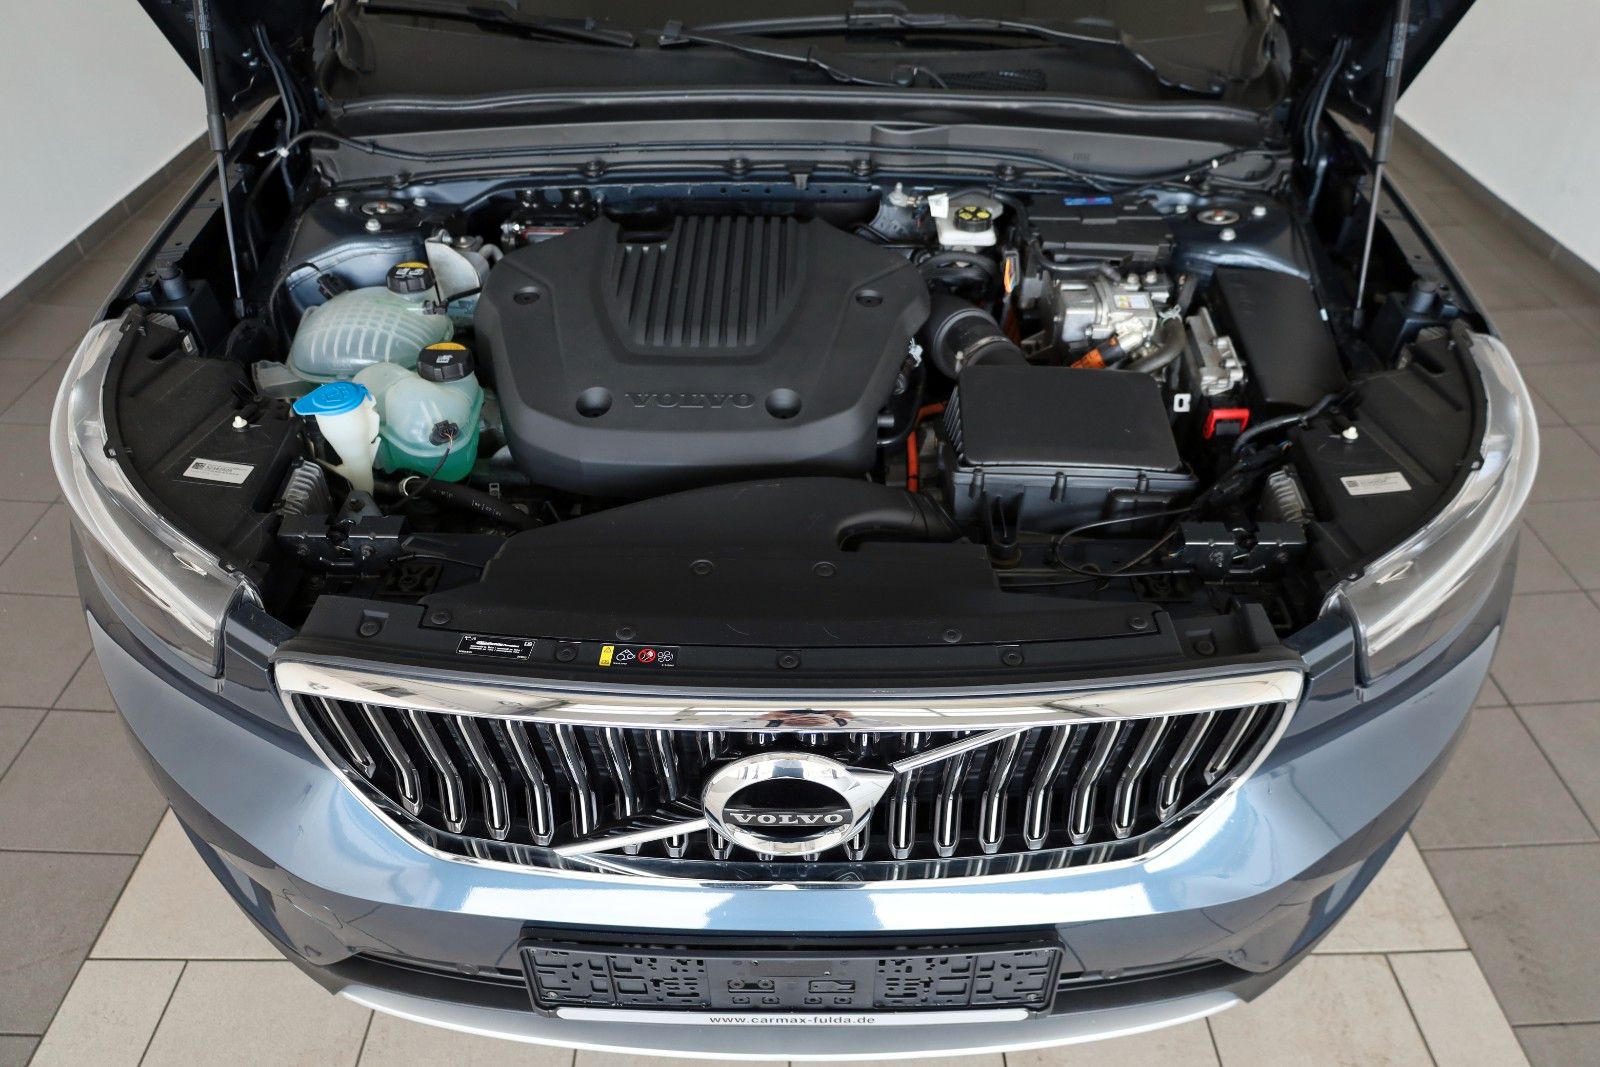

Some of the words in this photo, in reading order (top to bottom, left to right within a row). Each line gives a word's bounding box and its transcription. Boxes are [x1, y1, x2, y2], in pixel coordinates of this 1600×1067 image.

[624, 392, 756, 409] VOLVO
[729, 812, 844, 825] VOLVO
[709, 1015, 876, 1024] www.carmax-fulda.de
